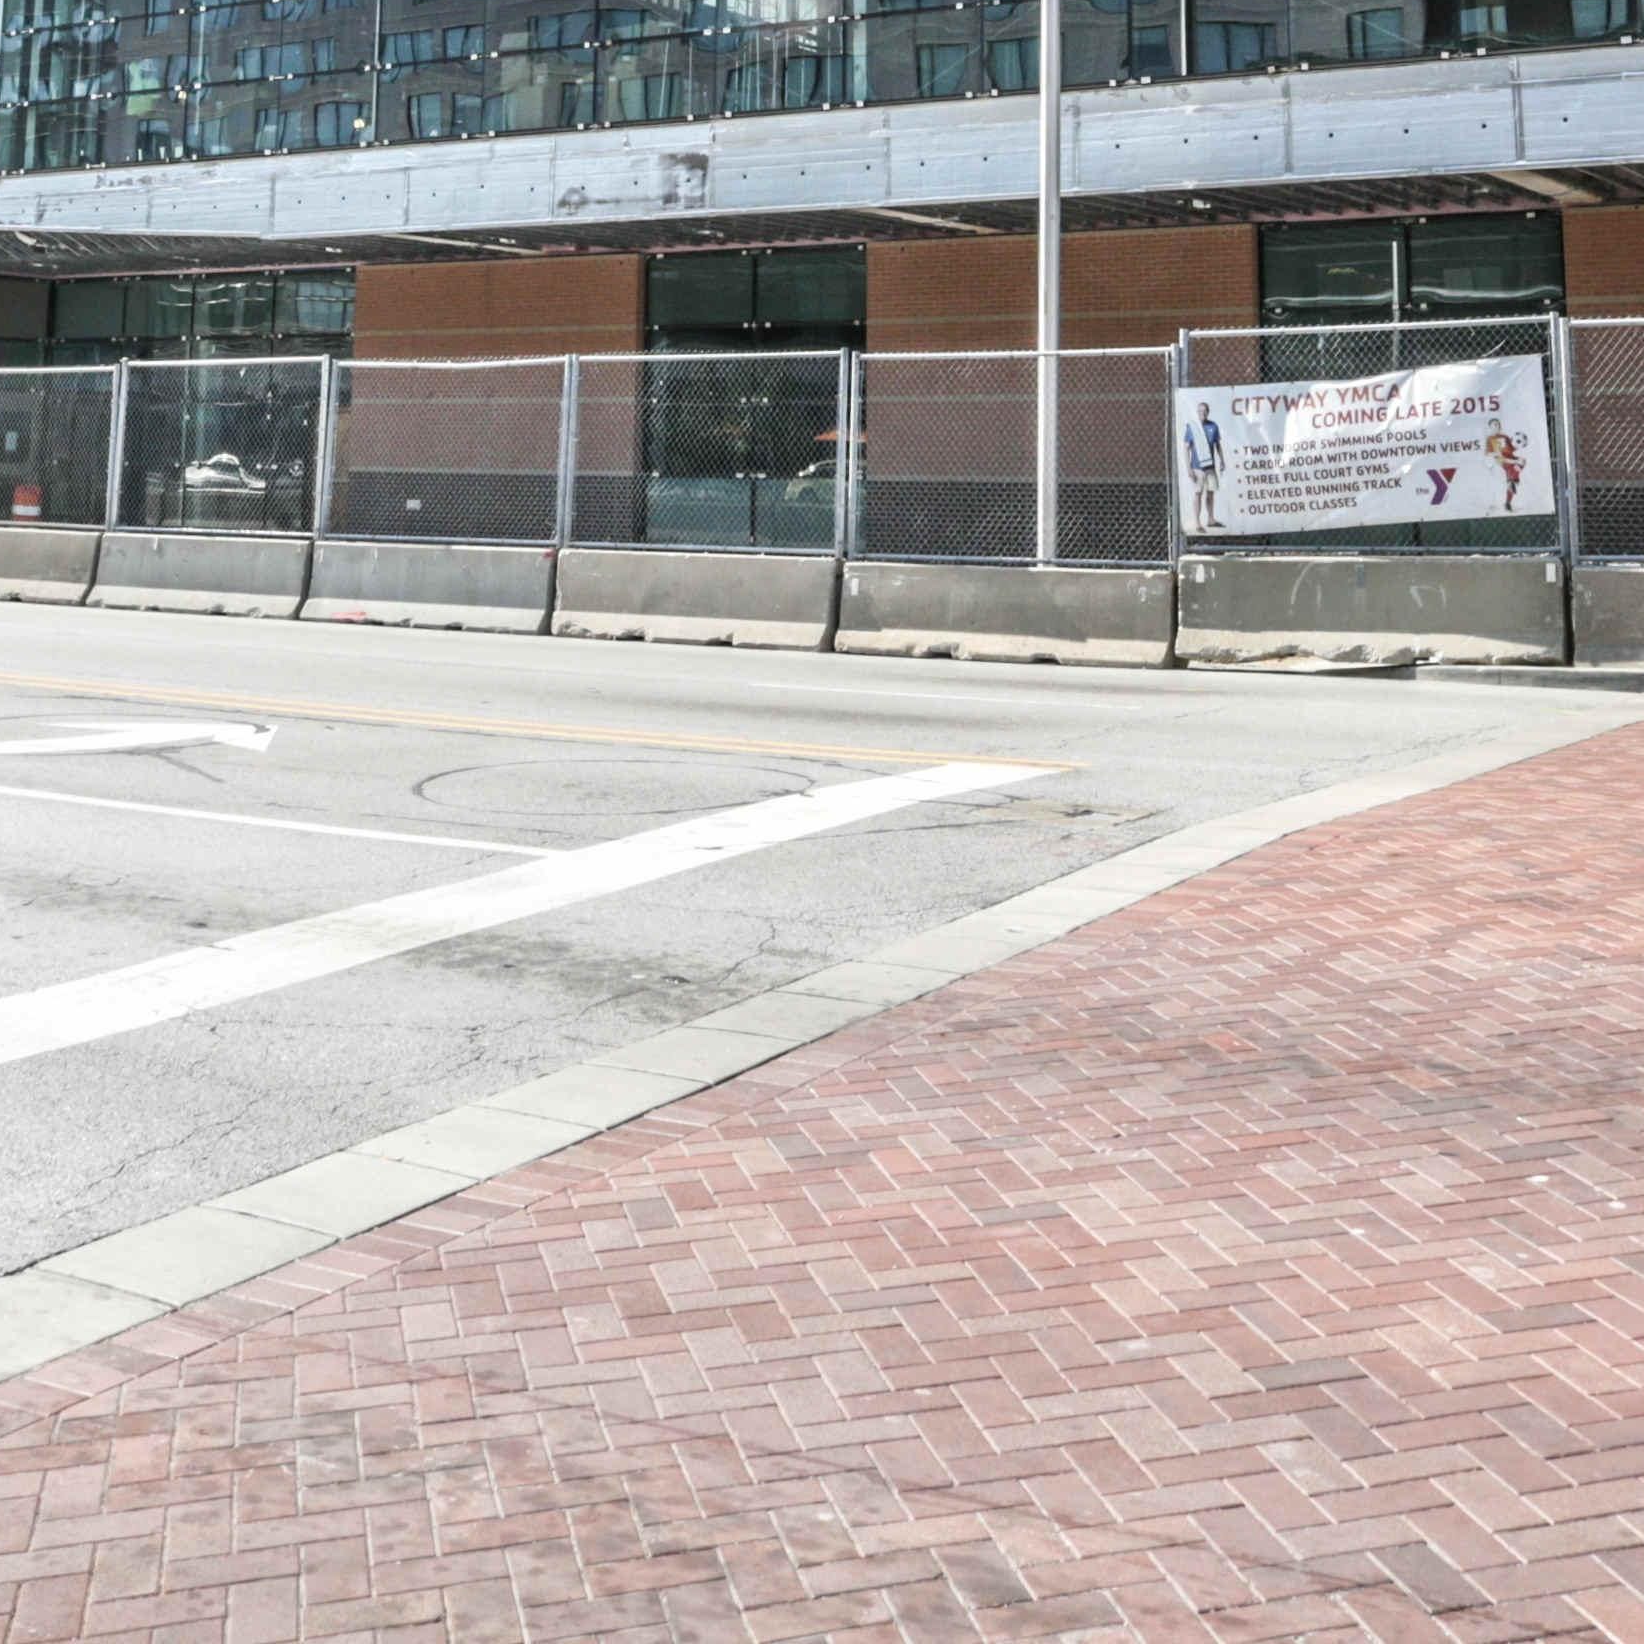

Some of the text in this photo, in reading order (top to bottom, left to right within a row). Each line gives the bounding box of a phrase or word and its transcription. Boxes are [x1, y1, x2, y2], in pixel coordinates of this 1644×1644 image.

[1231, 383, 1400, 416] CITYWAY YMCA
[1312, 395, 1500, 428] COMING LATE 2015
[1243, 439, 1481, 471] CARDIO ROOM WITH DOWNTOWN VIEWS
[1244, 429, 1427, 455] TWO INDOOR SWIMMING POOLS
[1245, 463, 1390, 485] THREE FULL COURT GYMS
[1247, 477, 1402, 501] ELEVATED RUNNING TRACK
[1248, 497, 1358, 516] OUTDOOR CLASSES
